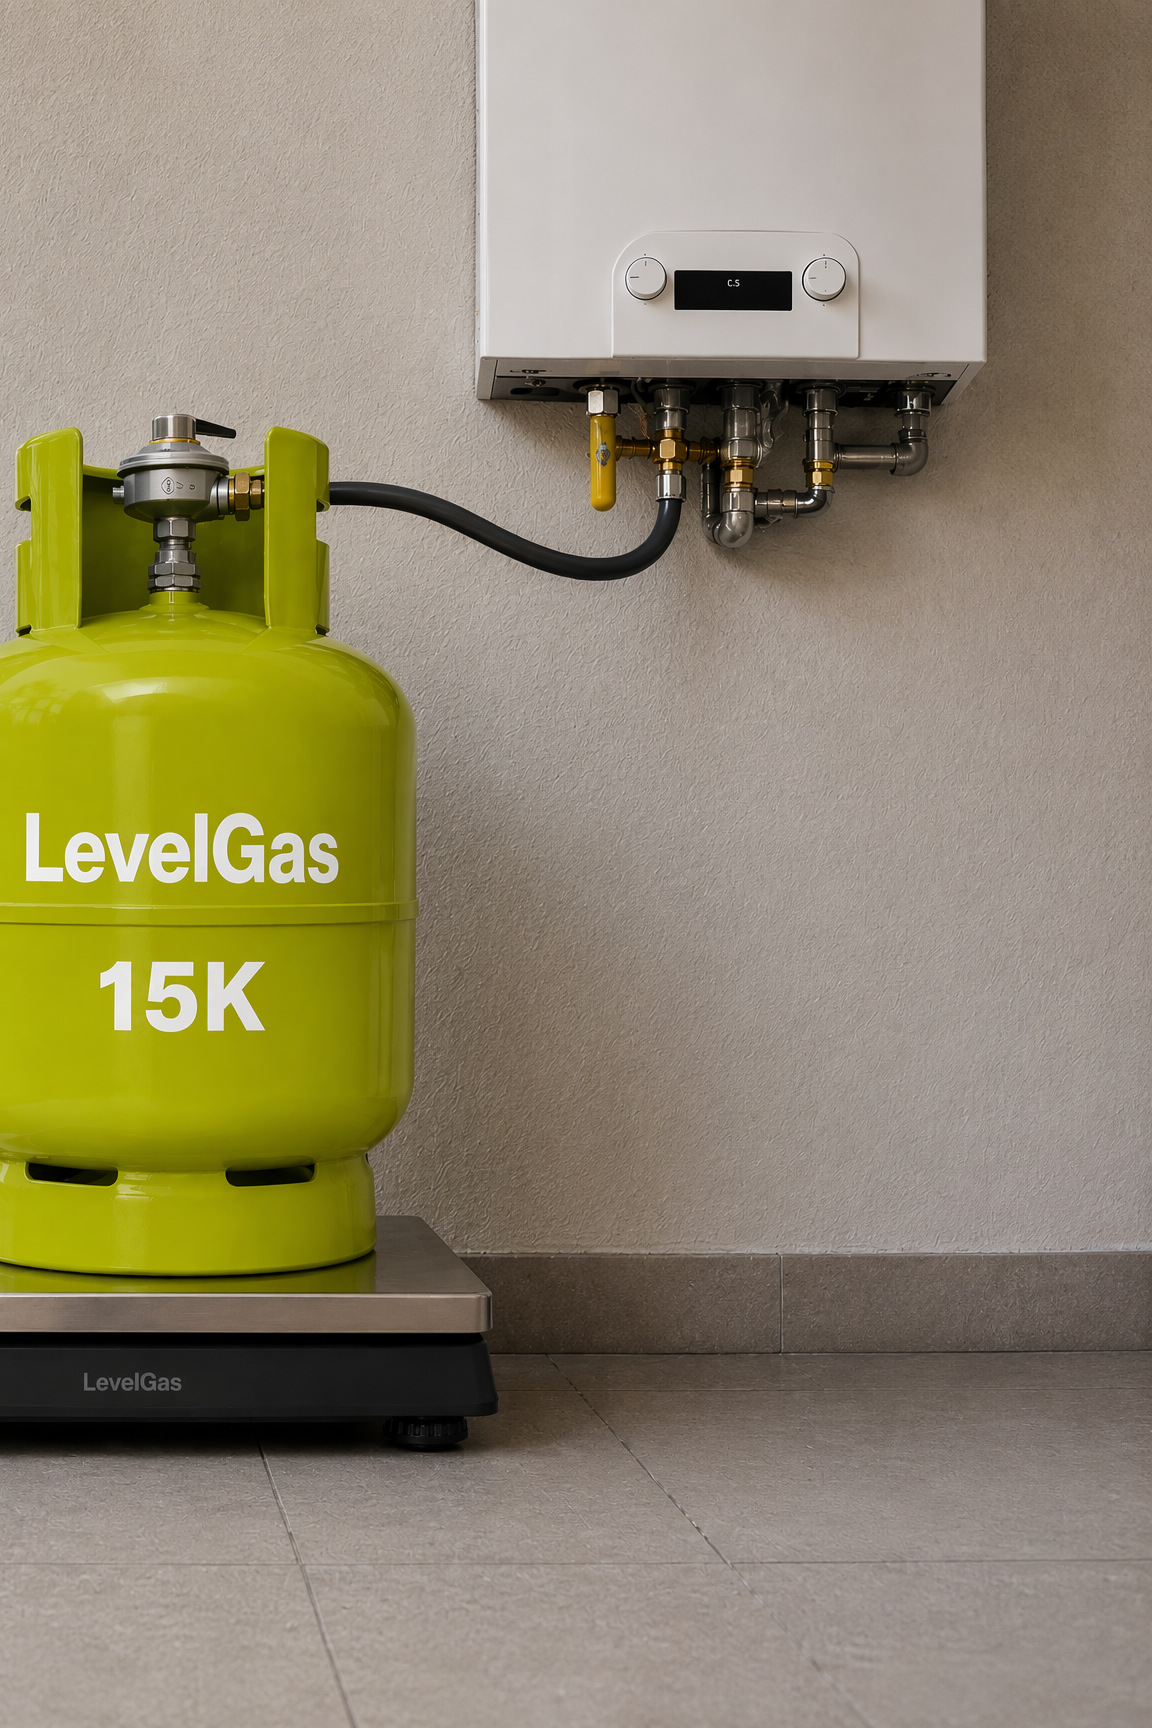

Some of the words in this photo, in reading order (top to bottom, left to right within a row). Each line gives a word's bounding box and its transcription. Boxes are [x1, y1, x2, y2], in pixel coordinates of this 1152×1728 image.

[25, 812, 339, 884] LevelGas
[100, 961, 266, 1032] 15K
[83, 1372, 182, 1391] LevelGas
